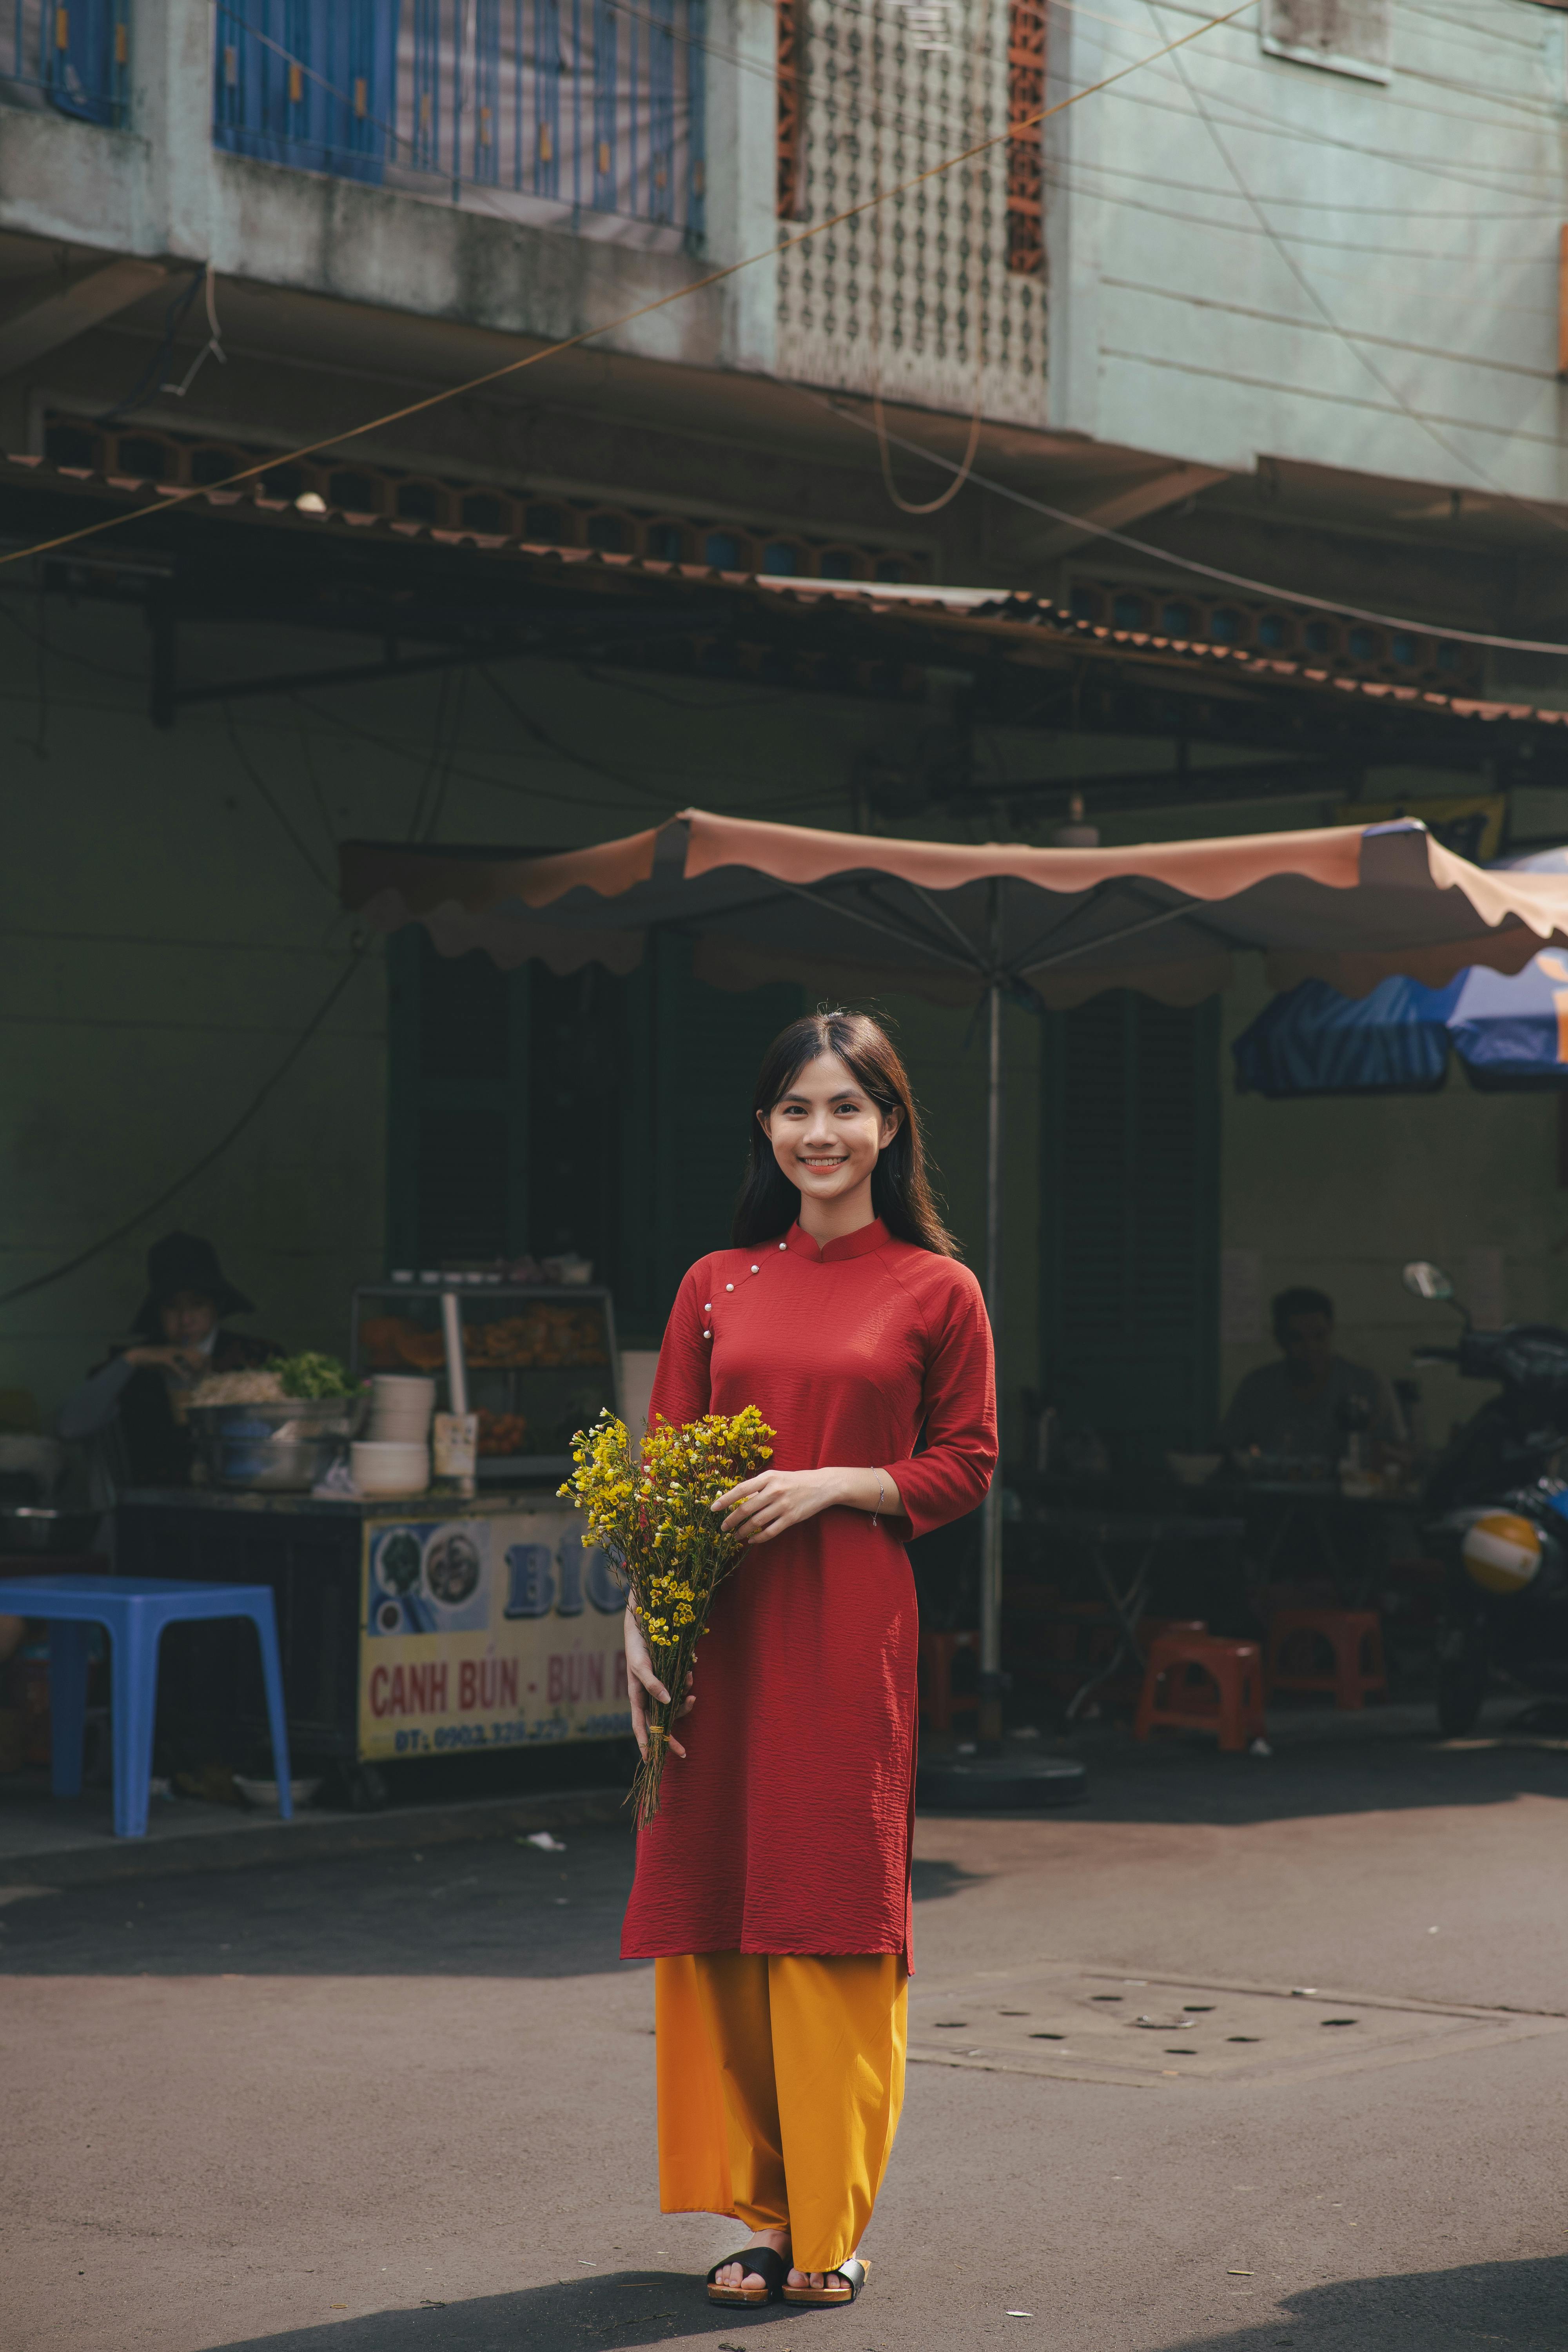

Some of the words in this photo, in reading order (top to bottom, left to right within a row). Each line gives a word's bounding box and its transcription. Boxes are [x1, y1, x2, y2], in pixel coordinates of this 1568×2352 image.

[369, 1661, 447, 1719] CANH
[458, 1642, 520, 1711] BÚN
[547, 1636, 605, 1704] BÚN
